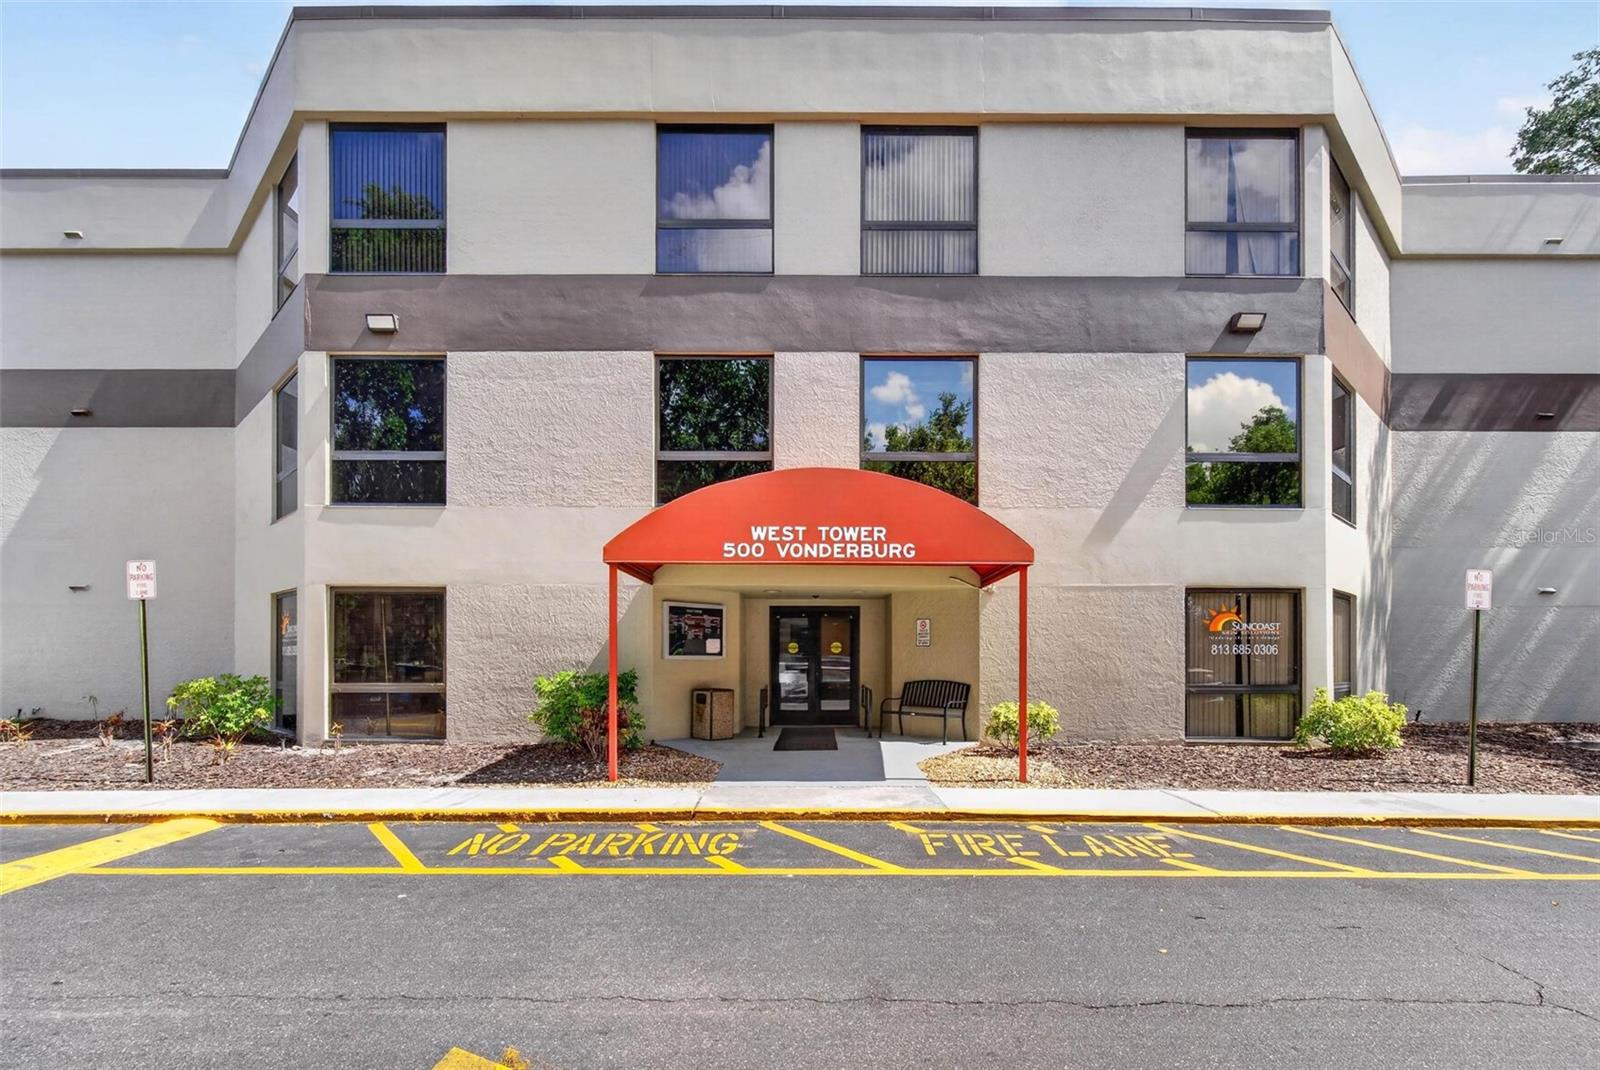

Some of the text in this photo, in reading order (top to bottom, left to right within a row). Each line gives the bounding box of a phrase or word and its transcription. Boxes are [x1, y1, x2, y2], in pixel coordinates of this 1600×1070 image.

[751, 526, 887, 541] WEST TOWER
[723, 543, 916, 558] 500 VONDERBURG
[136, 564, 147, 572] NO
[1232, 622, 1280, 631] SUNCOAST
[1211, 644, 1279, 655] 813.685.0306
[447, 833, 740, 855] NO PARKING
[919, 834, 1195, 857] FIRE LANE
